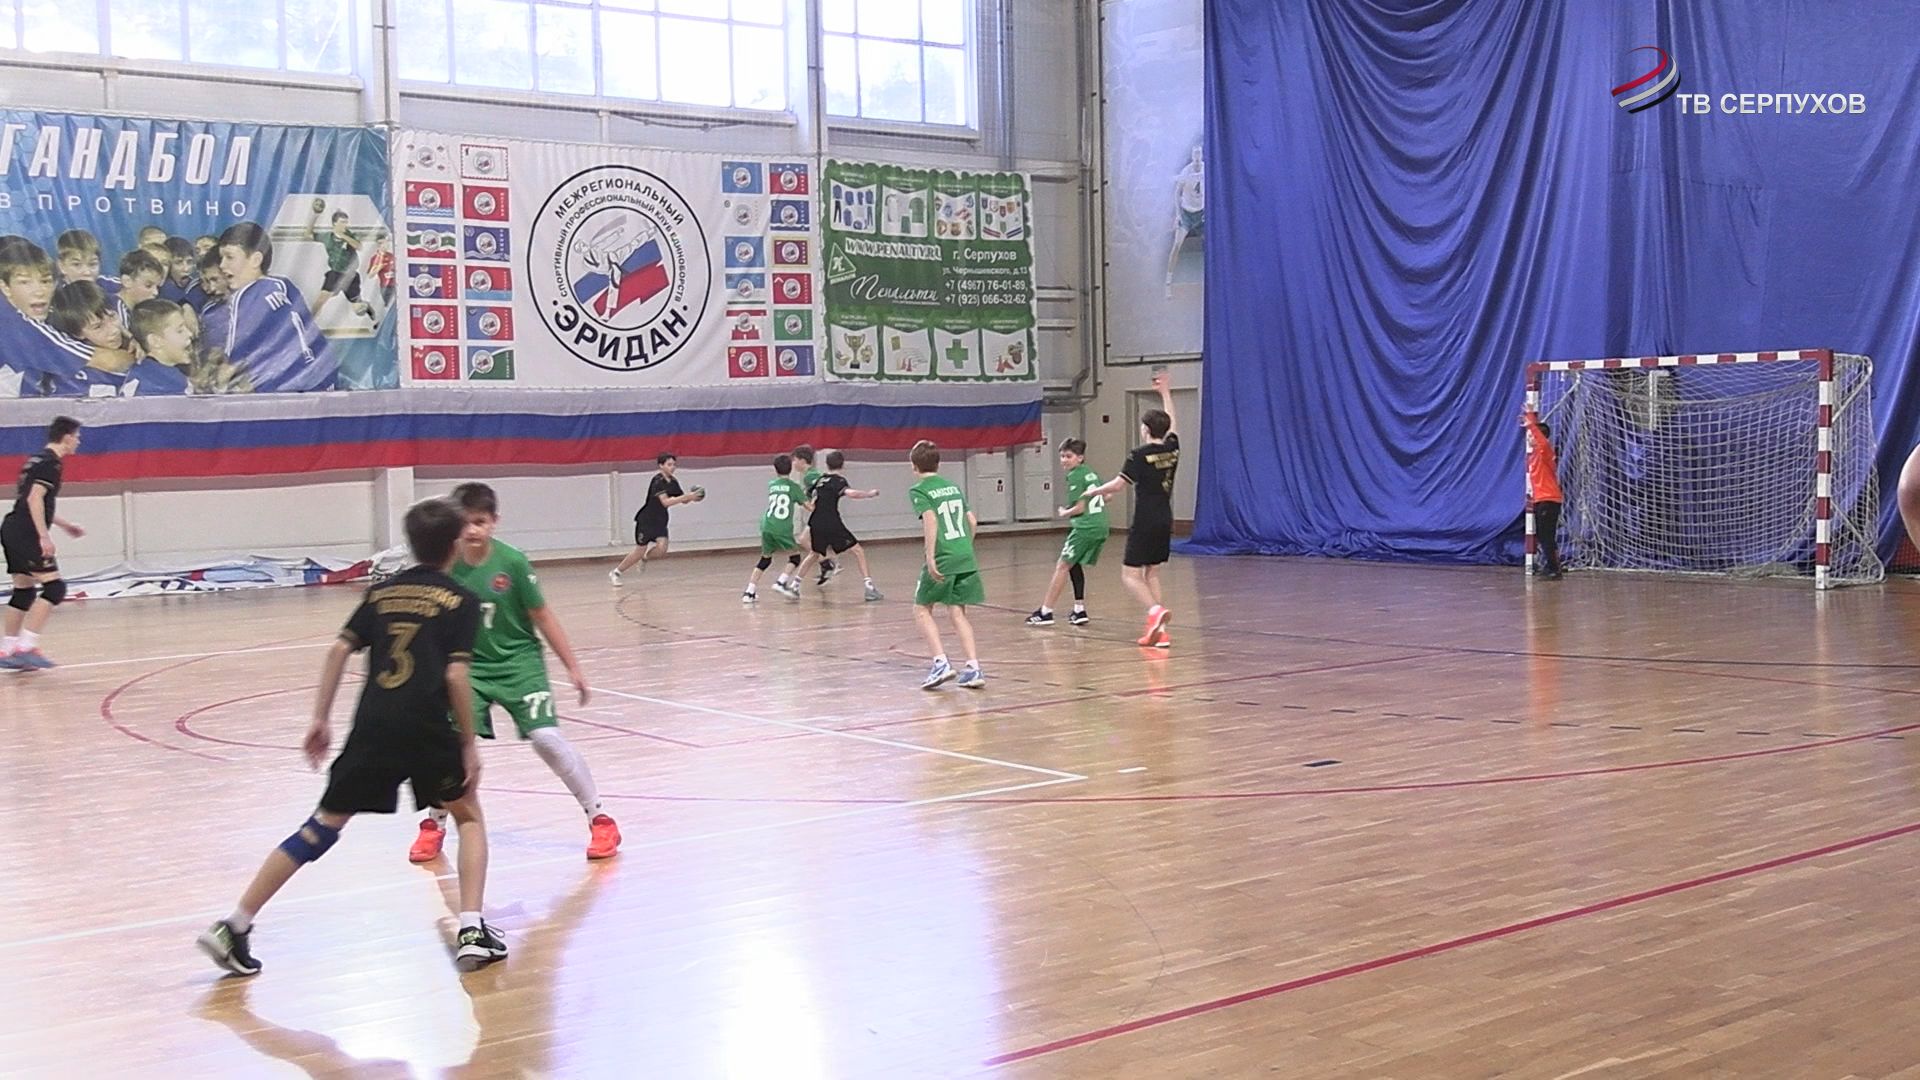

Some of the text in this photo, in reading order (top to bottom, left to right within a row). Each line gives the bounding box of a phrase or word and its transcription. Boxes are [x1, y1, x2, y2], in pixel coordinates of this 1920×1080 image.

[0, 123, 251, 190] ГАНДБОЛ
[39, 194, 247, 217] ПРОТВИНО
[555, 178, 684, 225] МЕЖРЕГИОНАЛЬНЫЙ
[554, 228, 569, 297] СПОРТИВНЫЙ
[566, 194, 655, 229] ПРОФЕССИОНАЛЬНЫЙ
[655, 210, 673, 232] КЛУБ
[953, 247, 1017, 263] г. Серпухов
[553, 304, 688, 367] ЭРИДАН
[937, 499, 966, 540] 17
[376, 622, 422, 690] 3
[523, 691, 552, 720] 77
